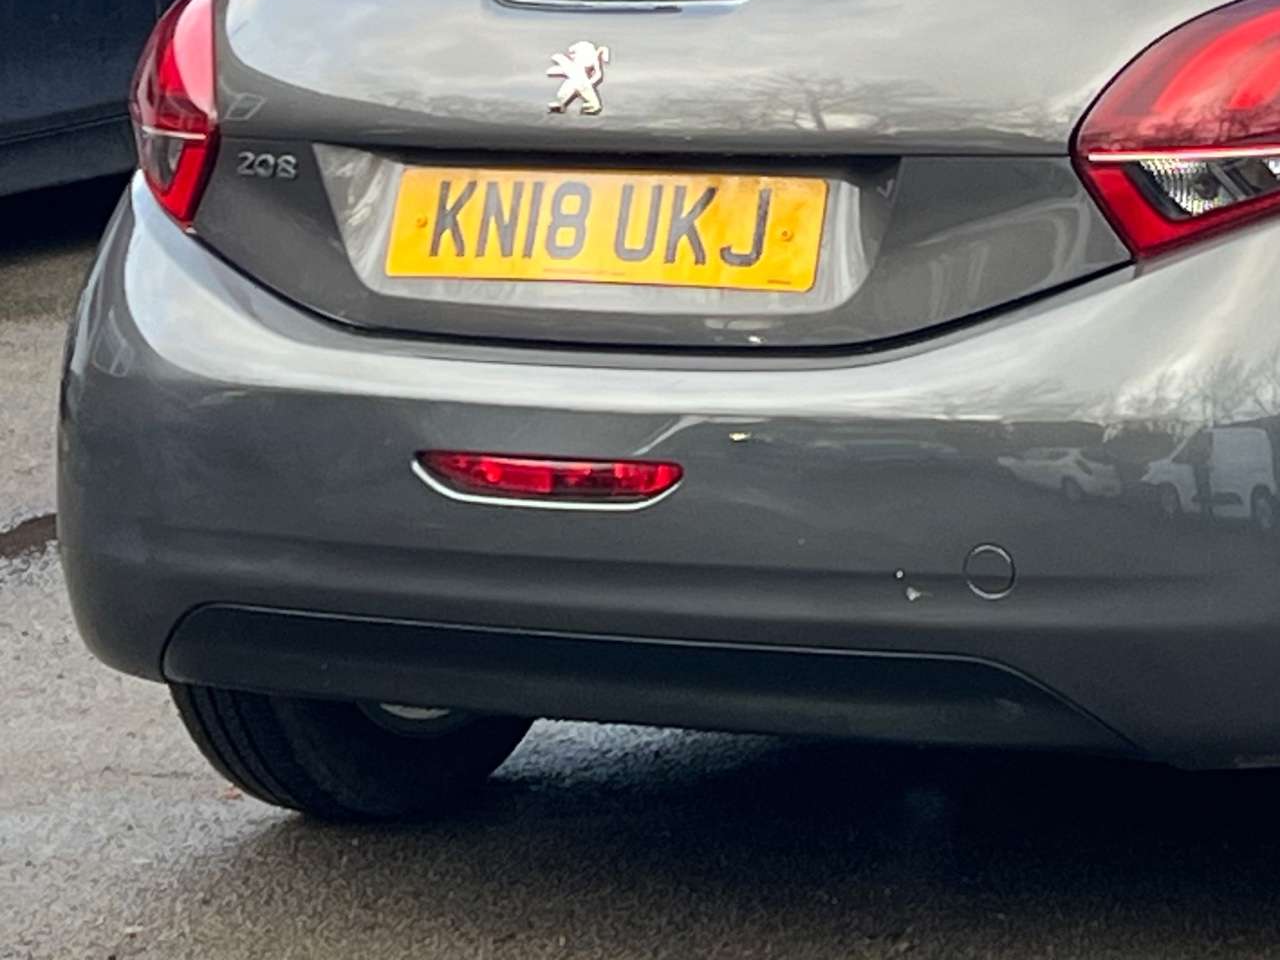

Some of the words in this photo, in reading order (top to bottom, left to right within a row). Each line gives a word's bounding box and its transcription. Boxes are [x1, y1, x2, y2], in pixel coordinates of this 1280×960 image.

[236, 151, 297, 179] 208
[428, 180, 593, 260] KN18
[613, 183, 773, 268] UKJ
